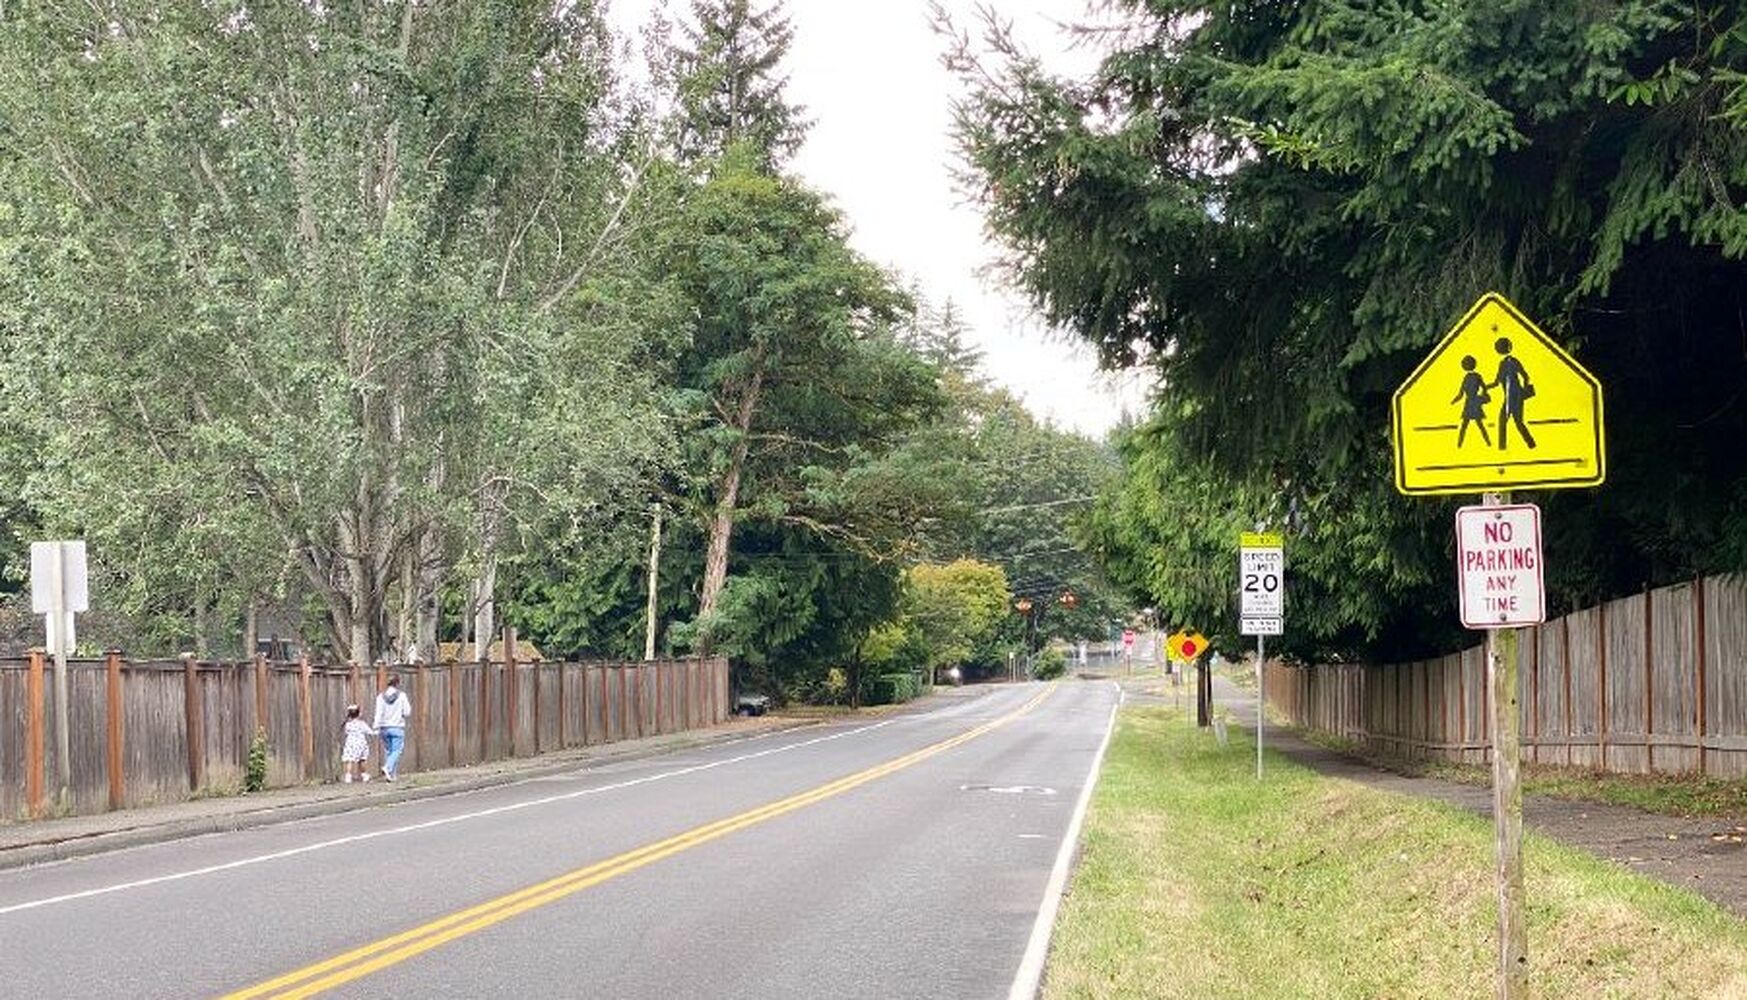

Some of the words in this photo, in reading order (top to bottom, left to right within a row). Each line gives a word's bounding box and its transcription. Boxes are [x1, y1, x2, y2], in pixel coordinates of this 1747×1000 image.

[1484, 521, 1513, 543] NO
[1466, 547, 1534, 571] PARKING
[1244, 574, 1278, 592] 20
[1486, 575, 1516, 591] ANY
[1484, 596, 1517, 611] TIME
